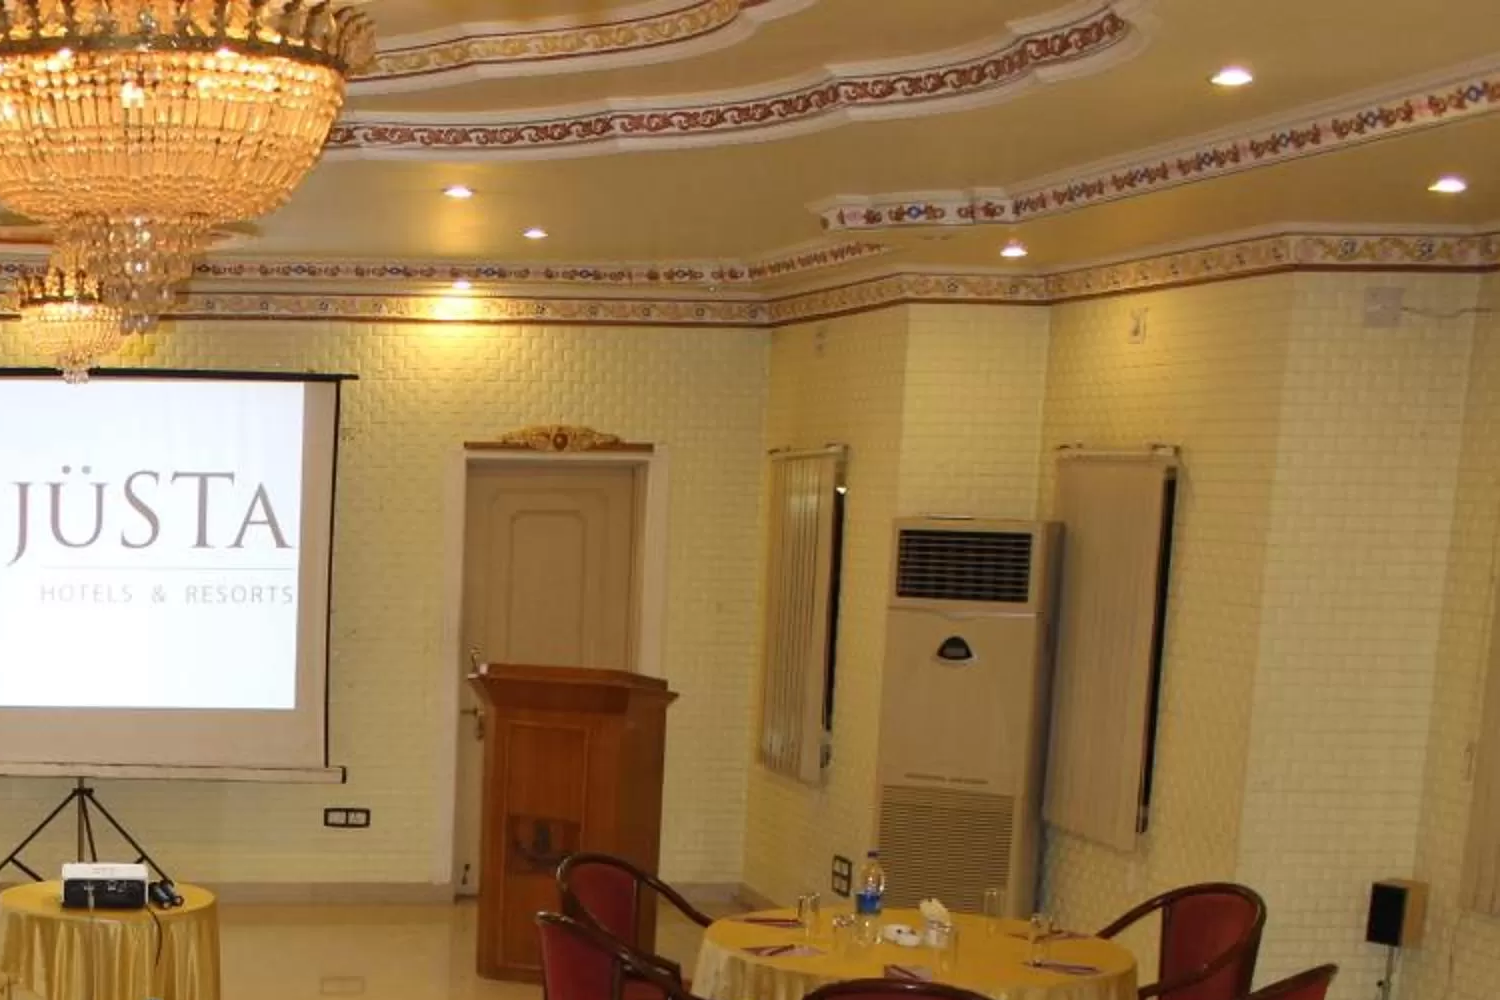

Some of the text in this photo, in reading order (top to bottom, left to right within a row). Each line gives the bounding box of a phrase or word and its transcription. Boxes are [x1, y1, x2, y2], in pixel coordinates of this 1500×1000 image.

[6, 465, 294, 567] JÜSTA
[40, 583, 294, 605] HOTELS & RESORTS
